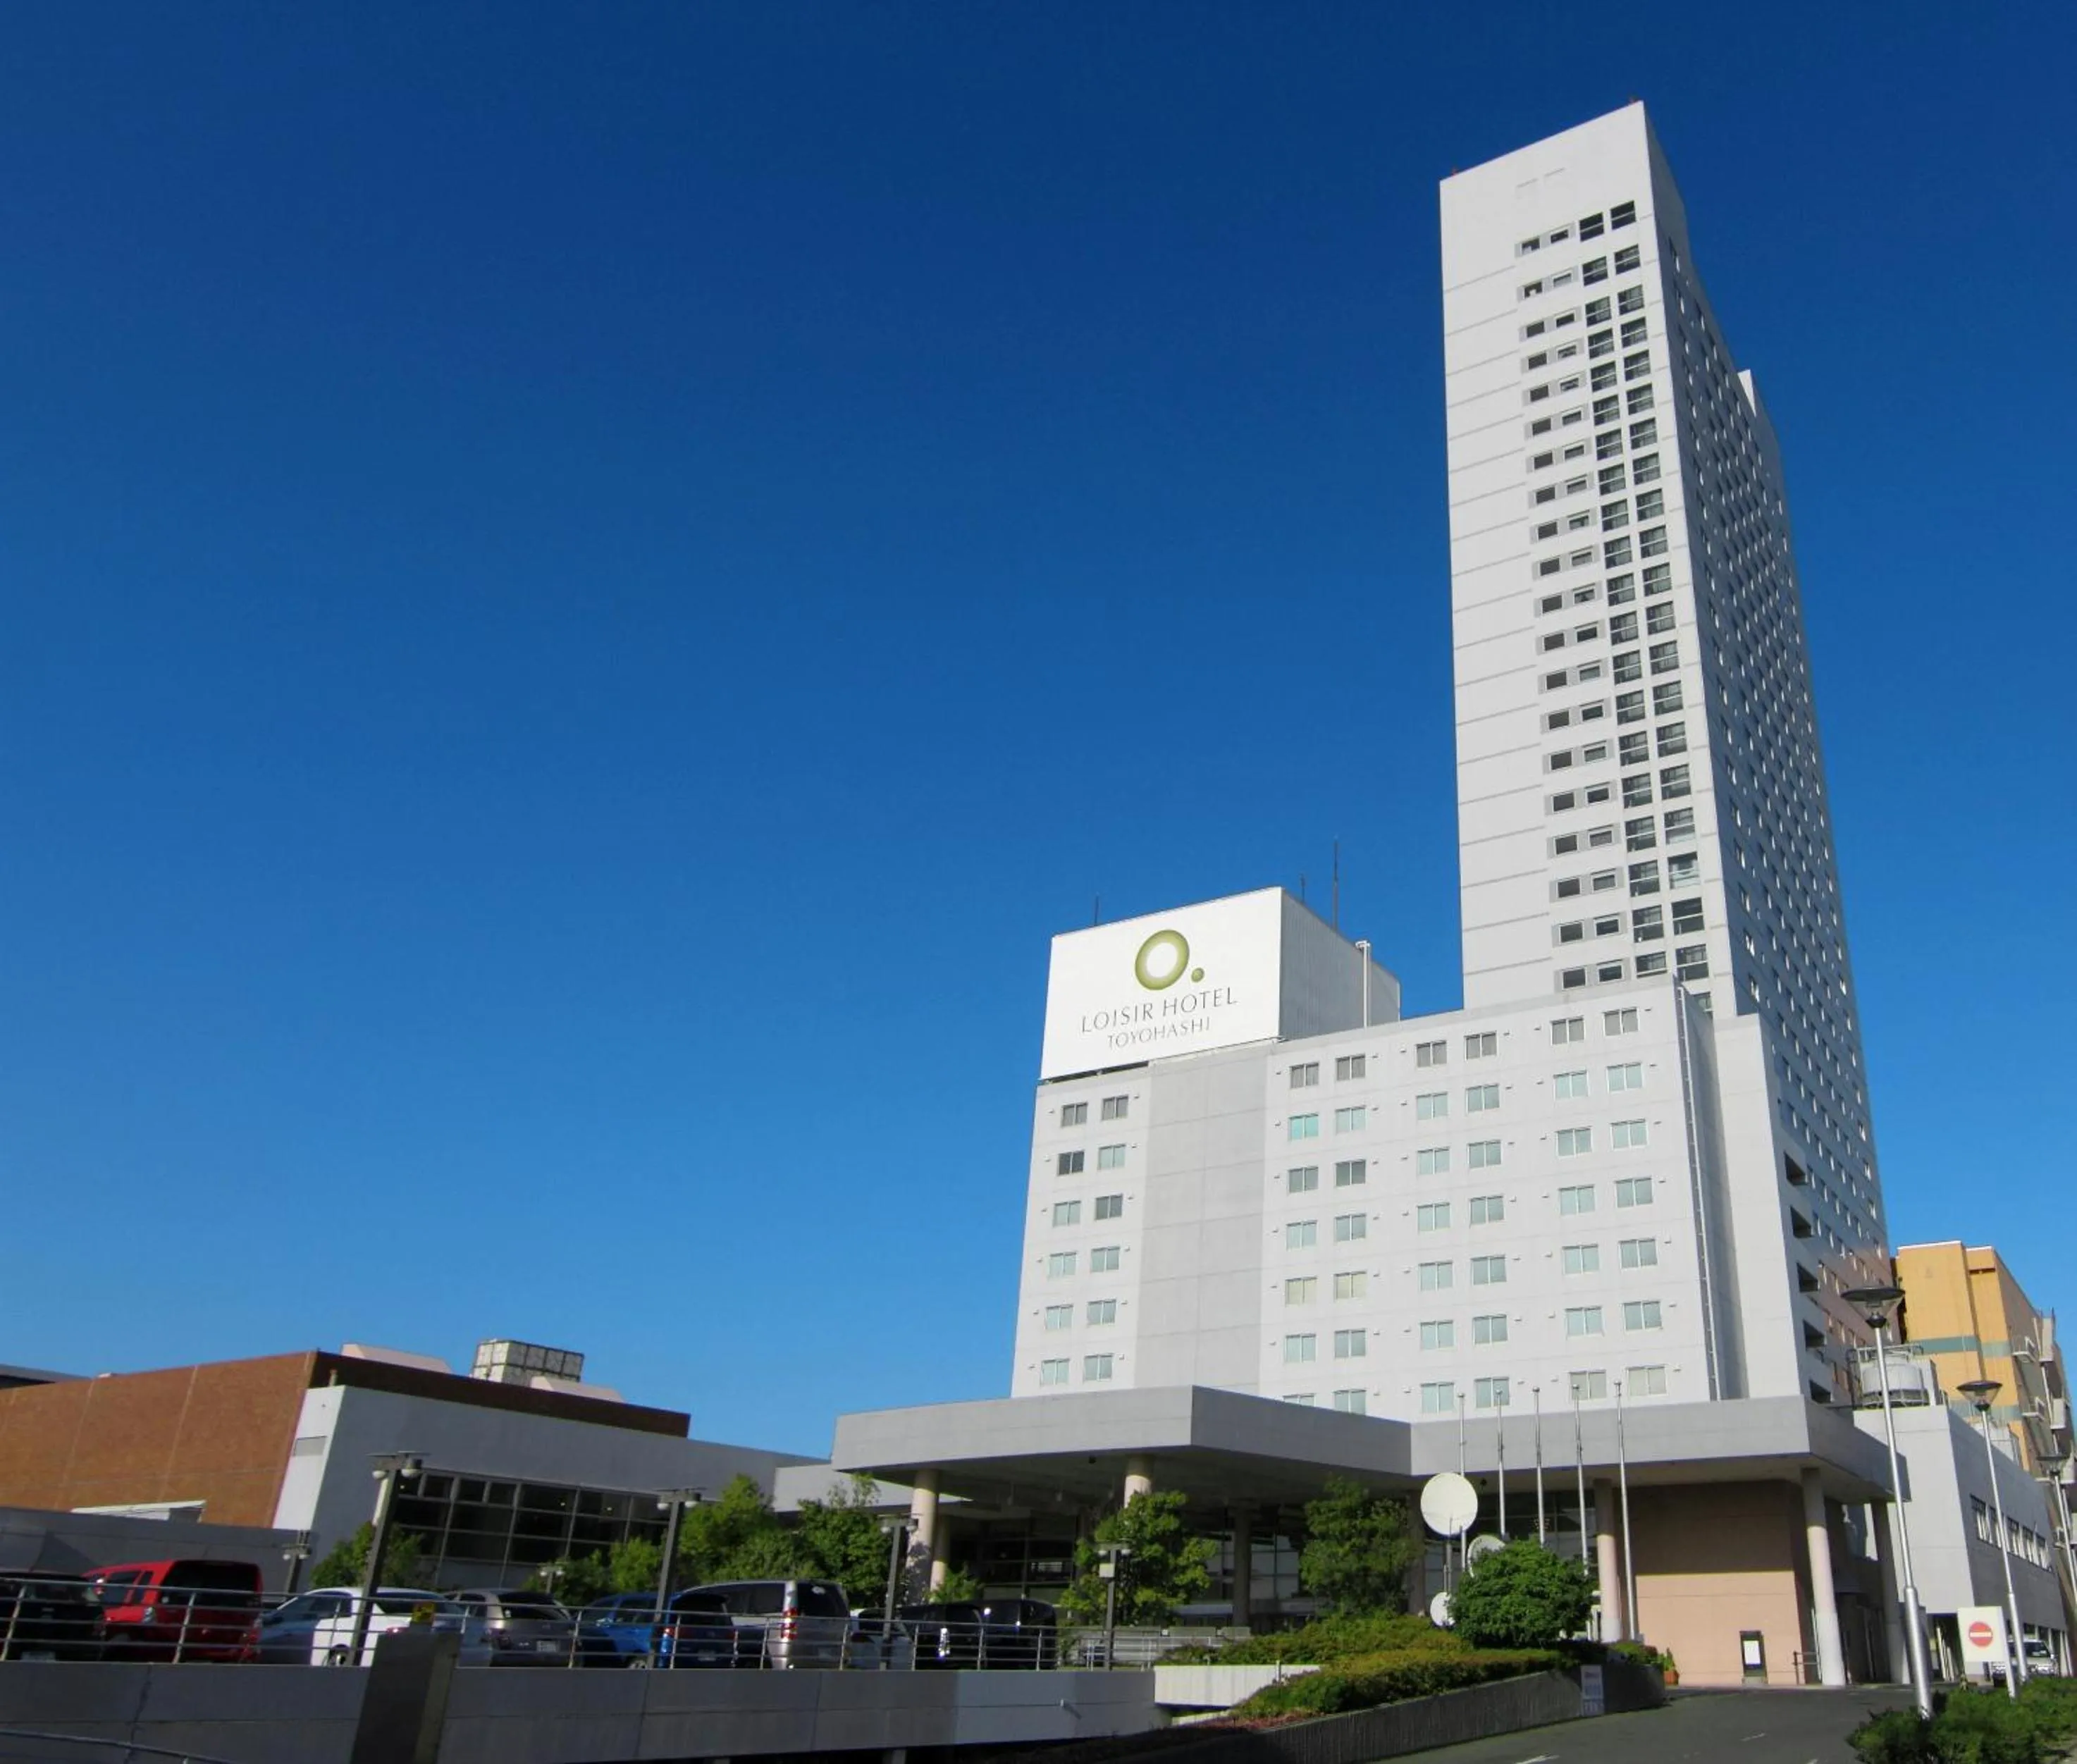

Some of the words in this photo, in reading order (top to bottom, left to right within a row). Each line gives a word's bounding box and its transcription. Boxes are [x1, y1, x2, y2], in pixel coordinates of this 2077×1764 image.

[1081, 1003, 1154, 1033] LOISIR
[1162, 987, 1238, 1016] HOTEL
[1107, 1017, 1210, 1050] TOYOHASHI
